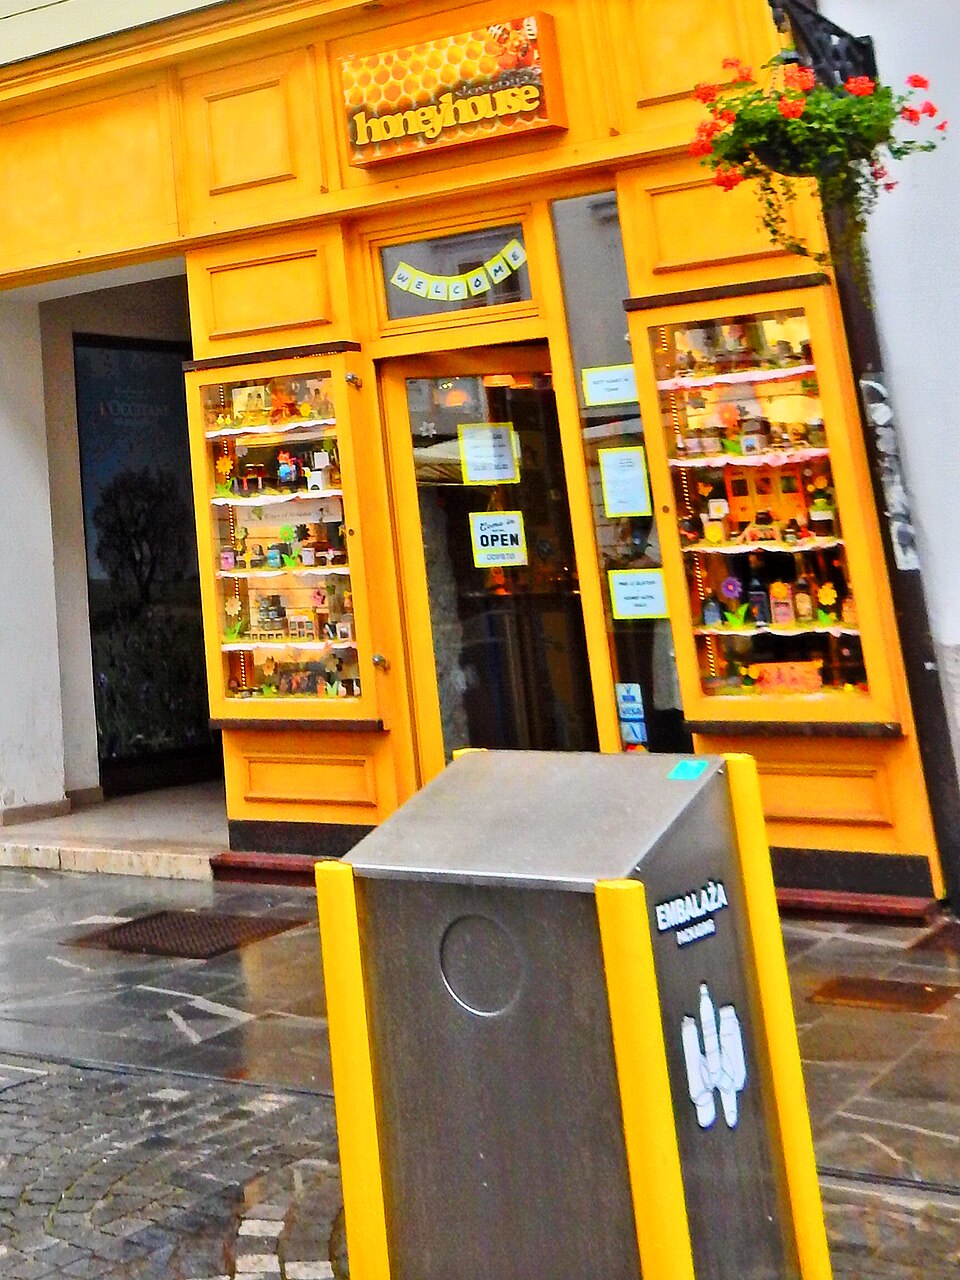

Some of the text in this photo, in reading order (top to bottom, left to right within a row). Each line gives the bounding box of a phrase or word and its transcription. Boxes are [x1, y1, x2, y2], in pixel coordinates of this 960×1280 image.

[353, 85, 540, 146] honeyhouse
[396, 250, 520, 294] WELCOME
[480, 534, 519, 547] OPEN
[655, 880, 729, 931] EMBALAŽA
